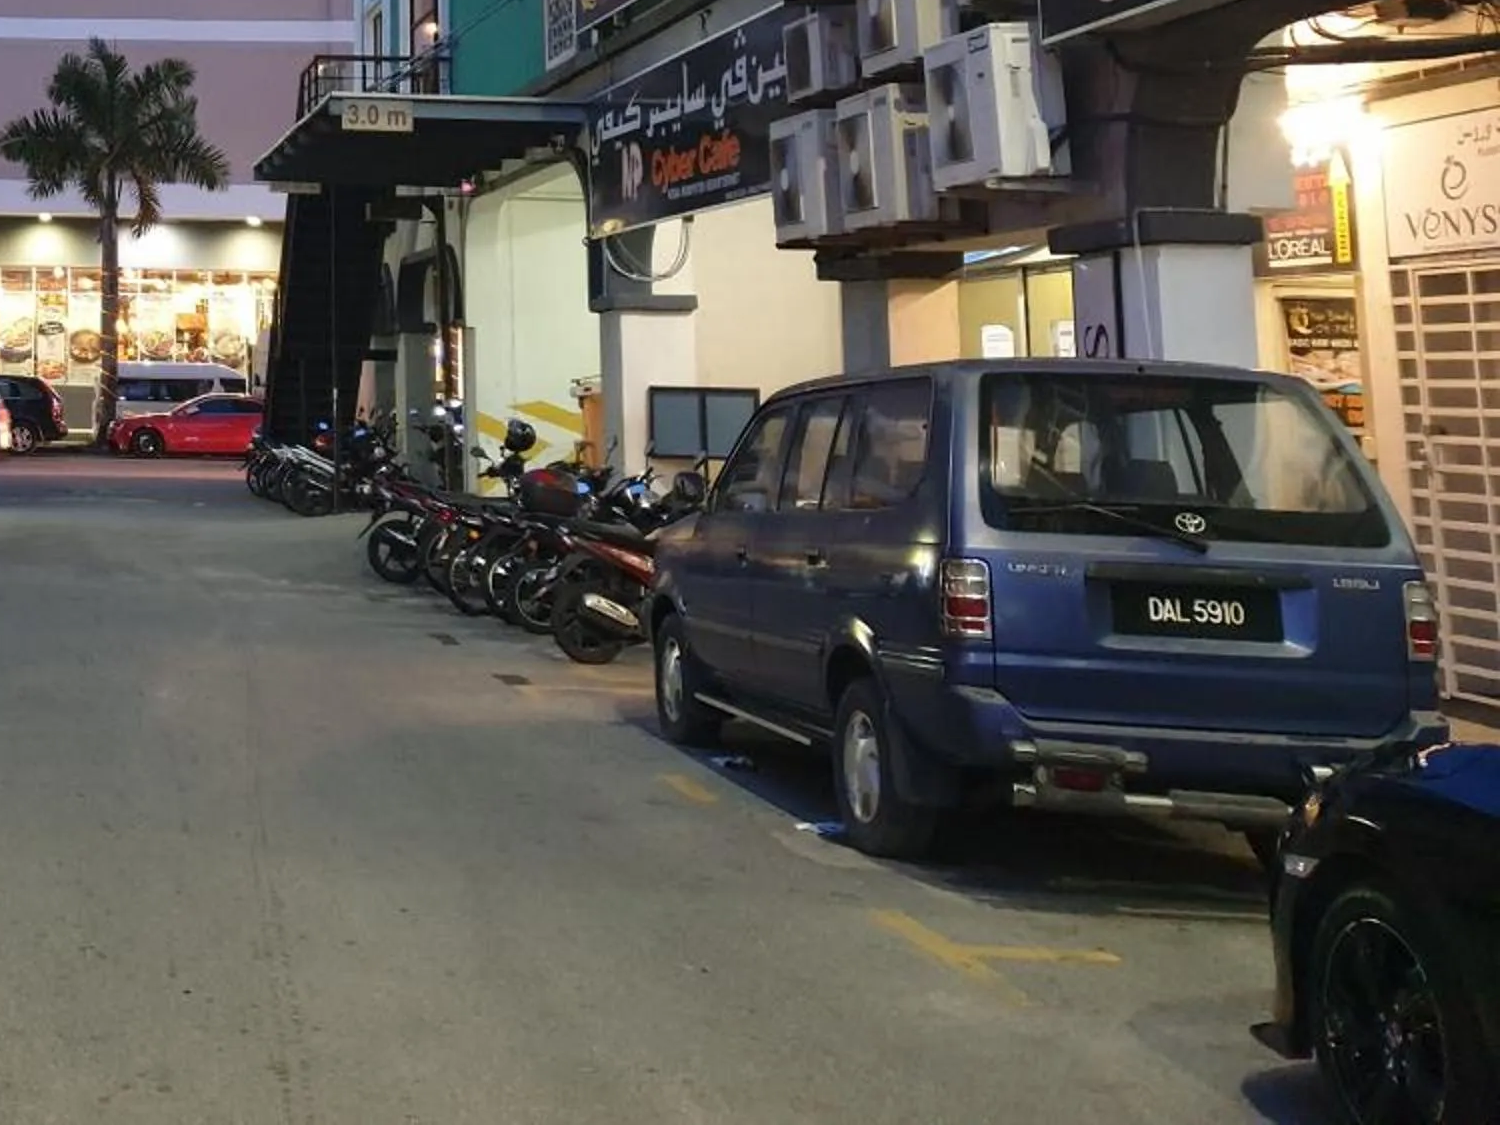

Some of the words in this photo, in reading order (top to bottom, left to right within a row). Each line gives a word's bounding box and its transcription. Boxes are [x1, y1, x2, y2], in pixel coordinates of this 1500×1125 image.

[347, 104, 379, 125] 3.0
[387, 110, 407, 126] m
[652, 145, 698, 194] Cyber
[1405, 204, 1500, 239] VeNYS
[1148, 597, 1190, 625] DAL
[1193, 599, 1245, 625] 5910
